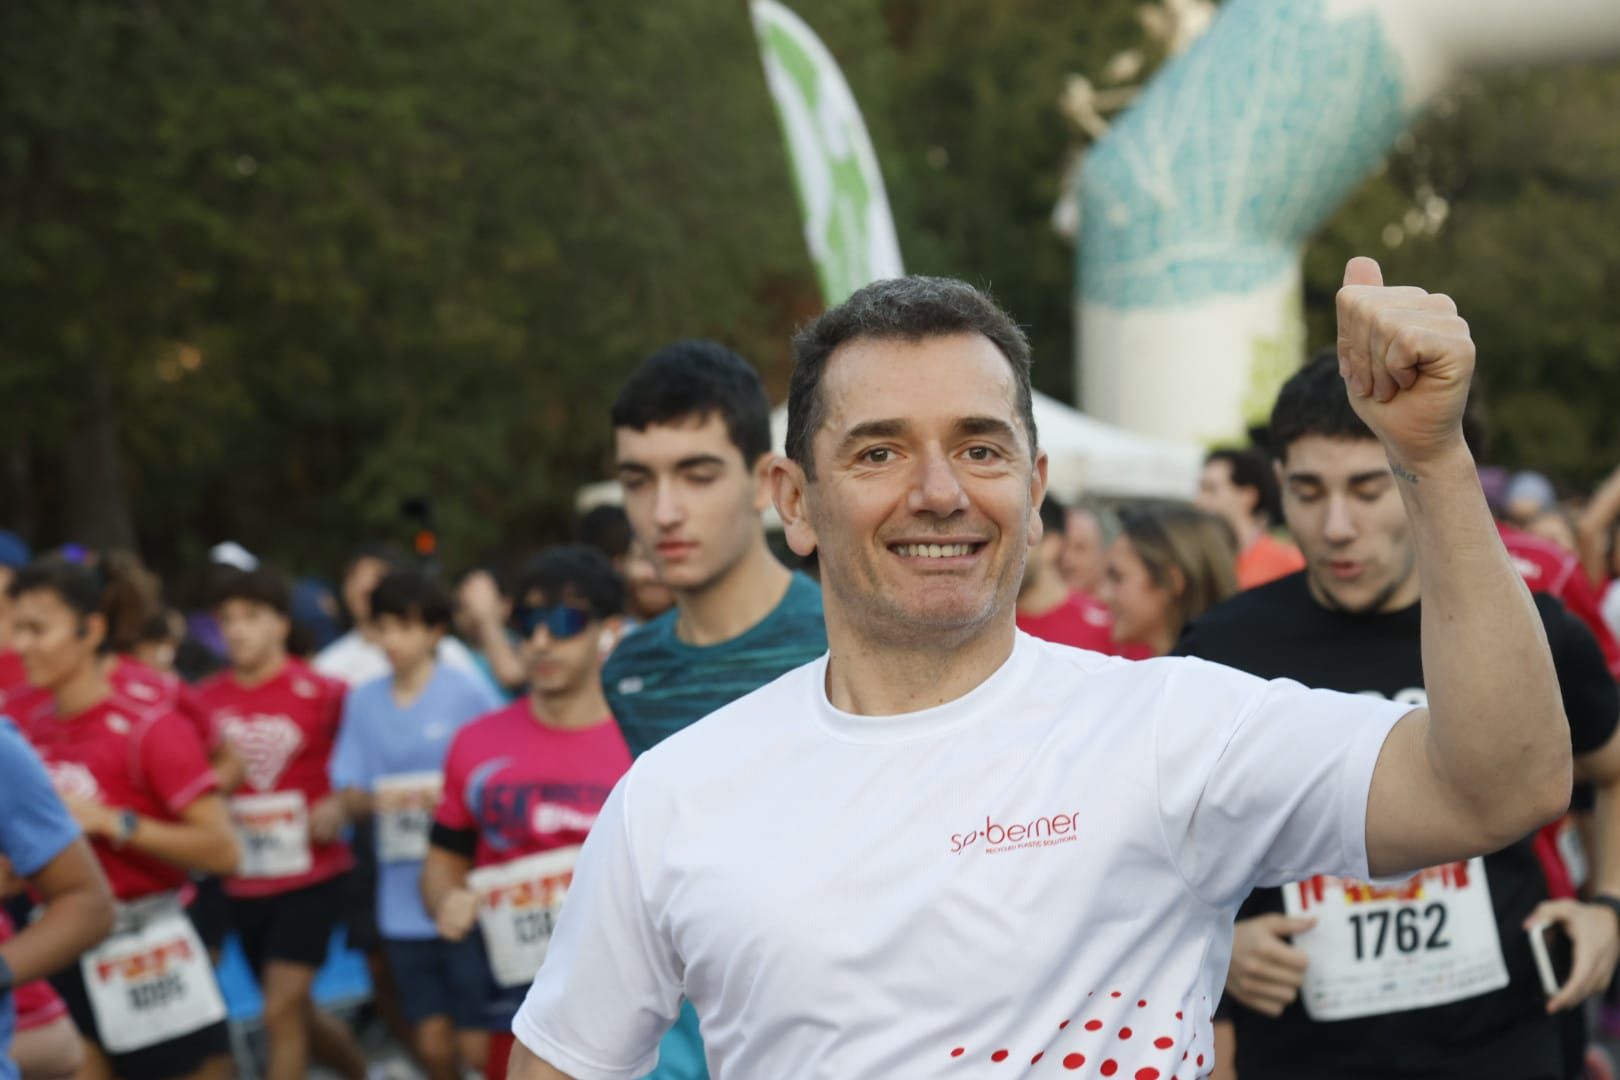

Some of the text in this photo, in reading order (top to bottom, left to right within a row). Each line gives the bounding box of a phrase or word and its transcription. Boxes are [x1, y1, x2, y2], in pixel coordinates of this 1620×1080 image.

[1018, 840, 1042, 850] PLASTIC
[1043, 835, 1077, 846] SOLUTIONS
[1348, 901, 1451, 961] 1762
